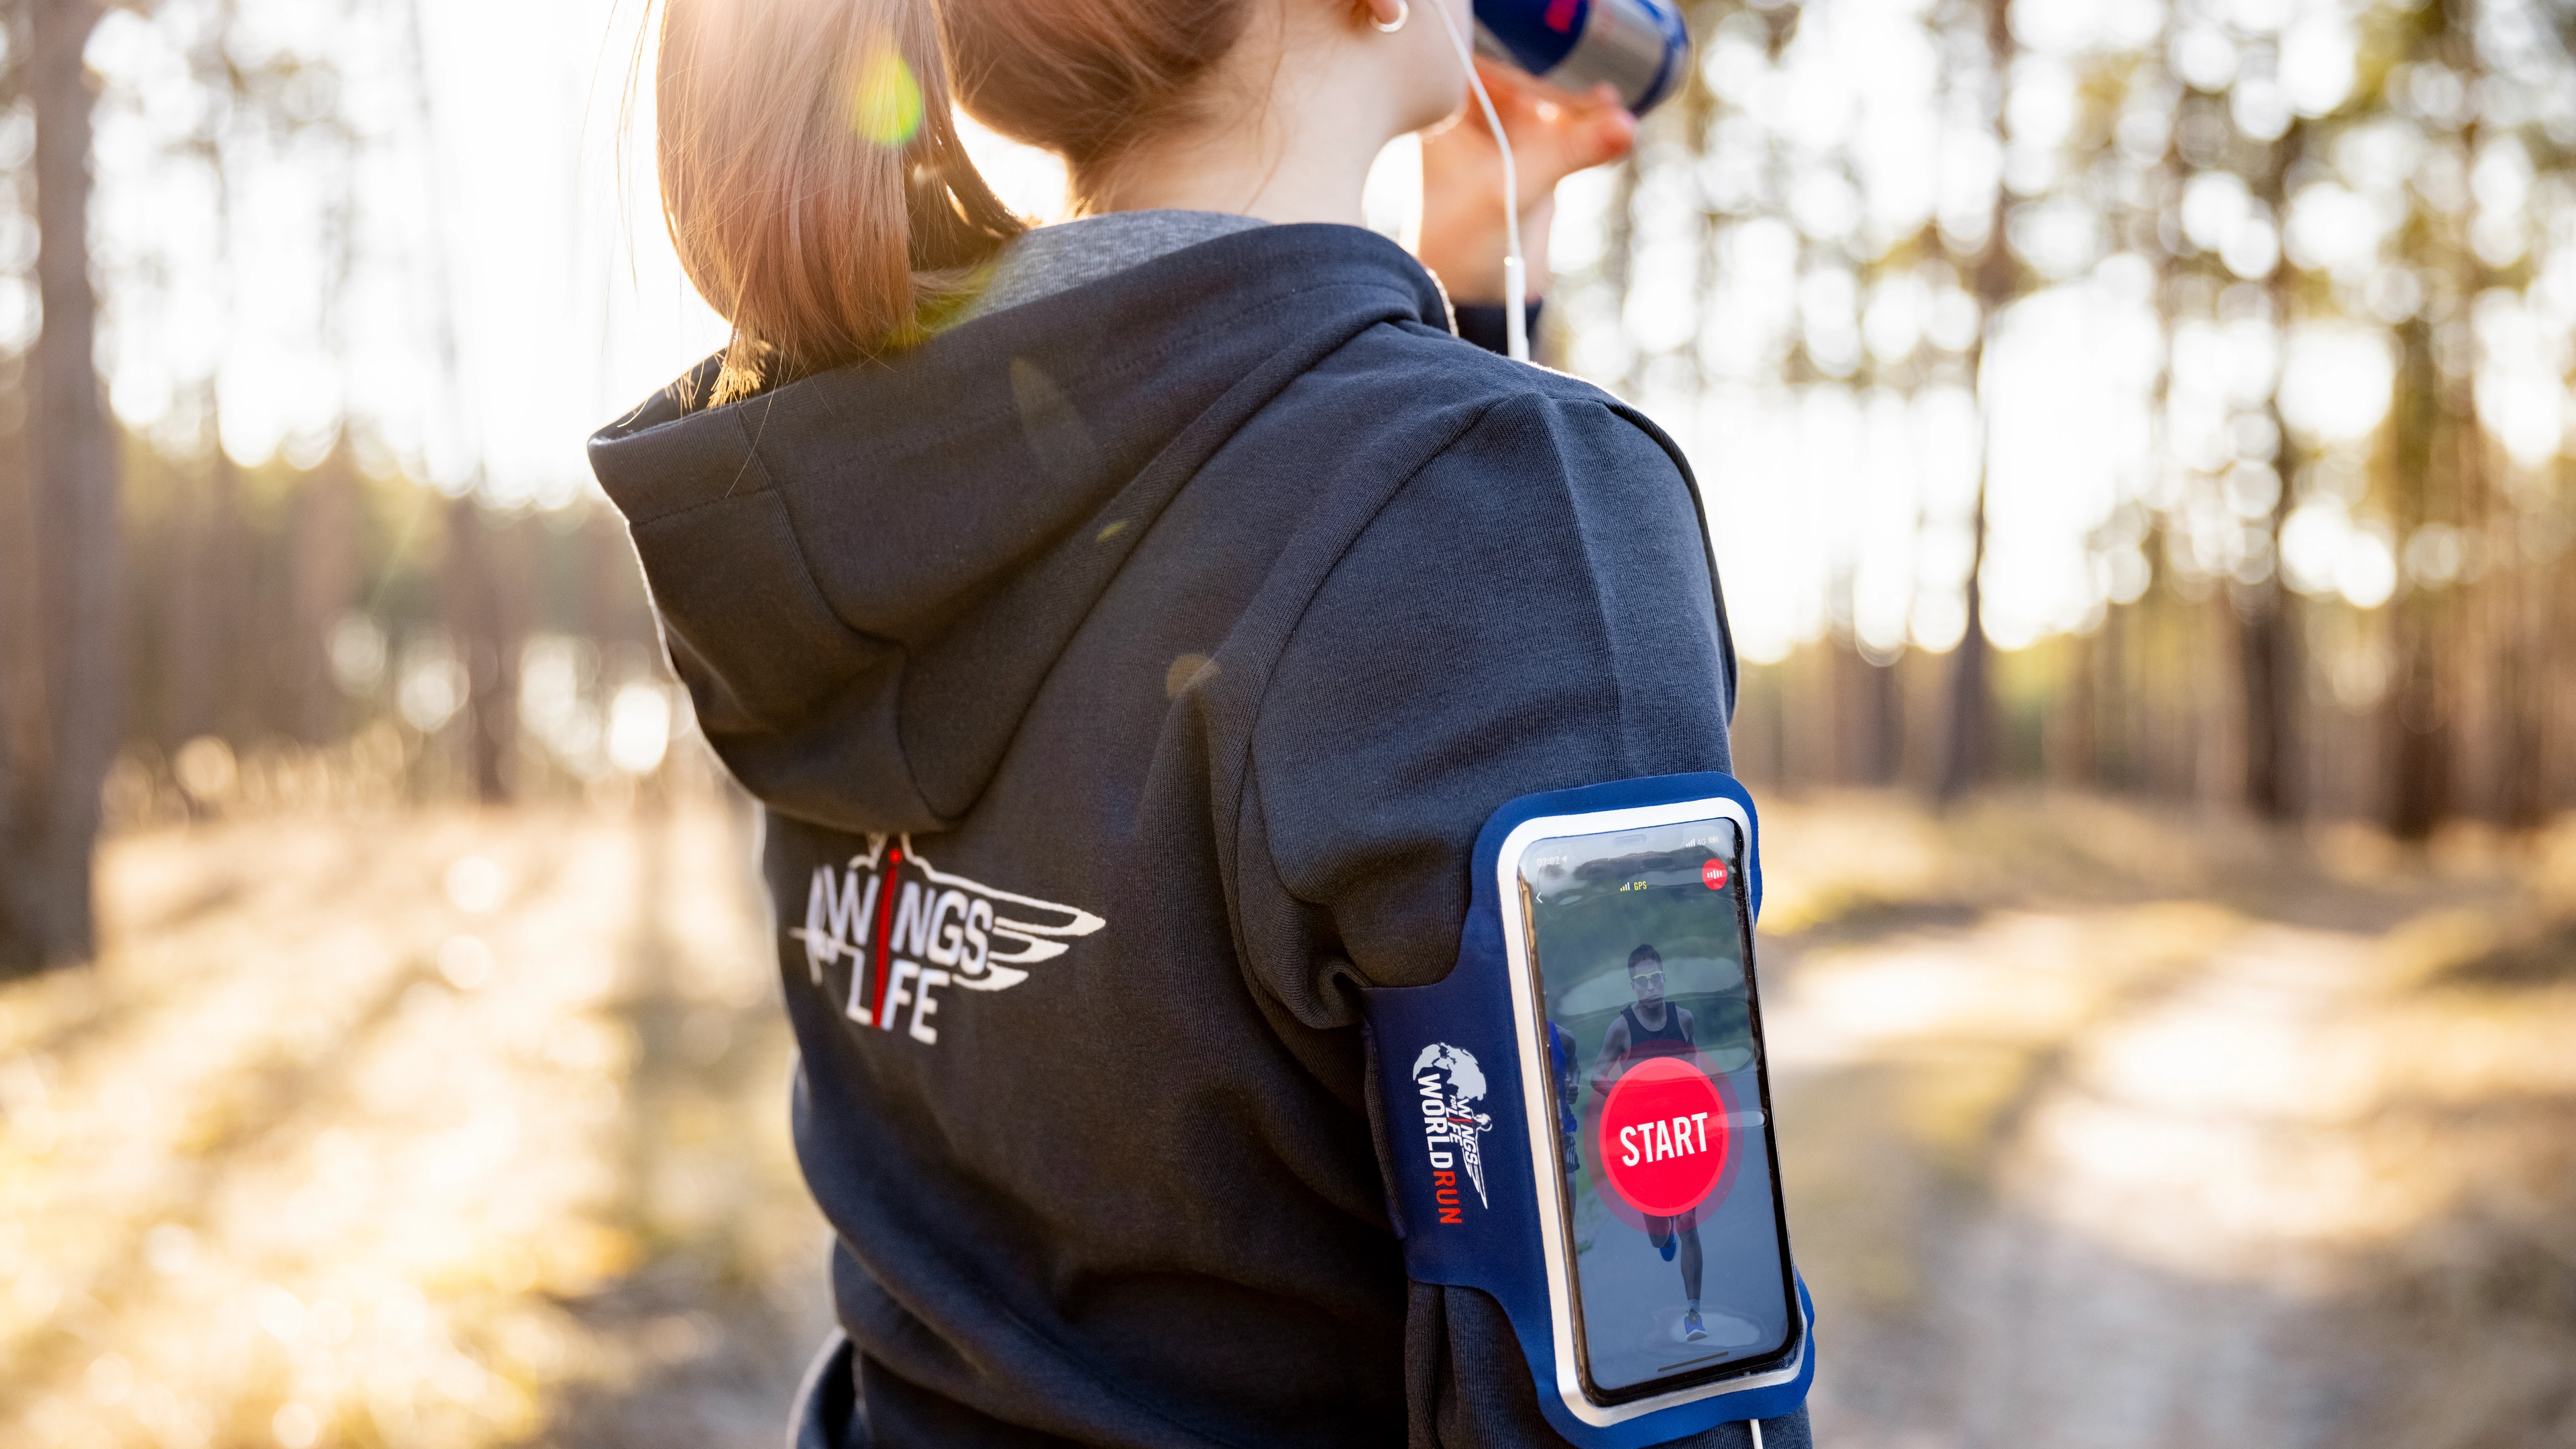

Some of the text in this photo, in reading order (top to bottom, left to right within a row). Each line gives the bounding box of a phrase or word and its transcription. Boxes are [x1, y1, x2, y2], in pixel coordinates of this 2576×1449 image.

[1537, 855, 1560, 867] 07:02
[1697, 838, 1706, 846] 4G
[1633, 881, 1647, 891] GPS
[824, 863, 994, 975] WINGS
[847, 949, 950, 1045] LIFE
[1446, 1094, 1463, 1146] FOR LIFE
[1457, 1098, 1479, 1165] WINGS
[1620, 1112, 1708, 1167] START
